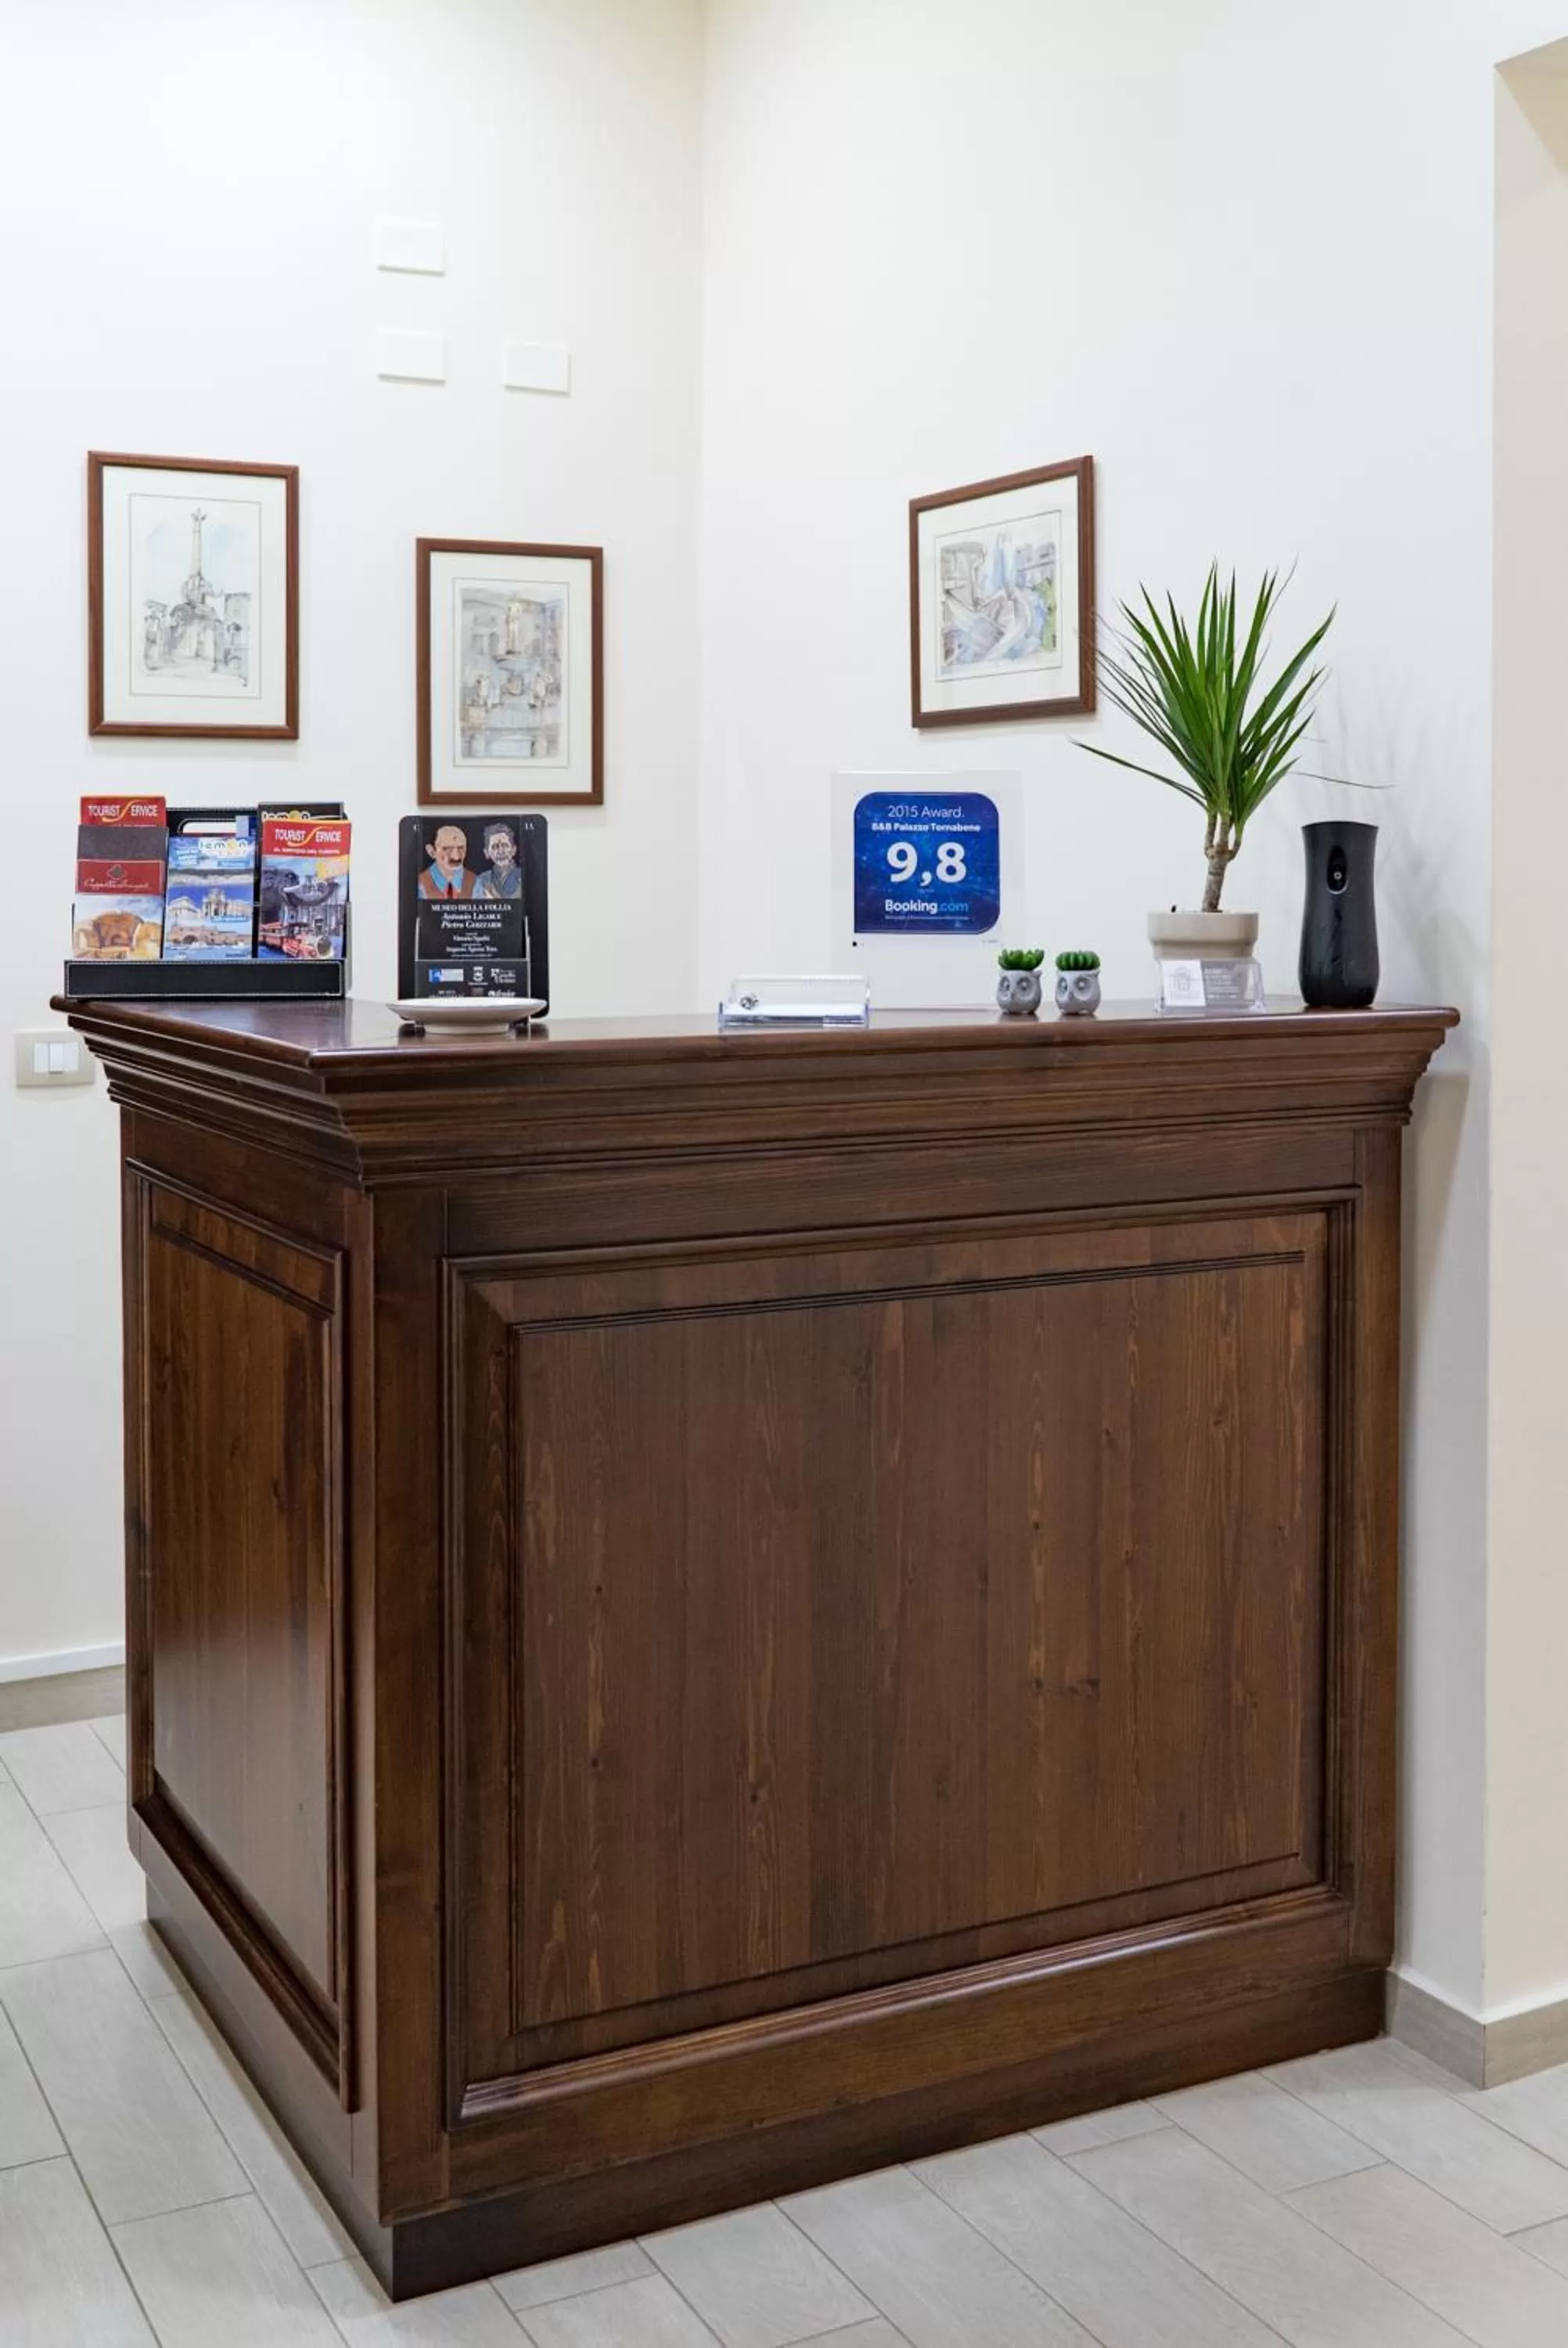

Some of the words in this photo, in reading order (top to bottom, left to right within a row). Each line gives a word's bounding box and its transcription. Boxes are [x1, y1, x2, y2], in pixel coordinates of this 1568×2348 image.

[87, 804, 120, 817] TOURIST
[887, 805, 919, 818] 2015
[921, 805, 965, 818] Award.
[871, 823, 892, 831] B&B
[893, 823, 930, 832] Palazzo
[930, 823, 981, 832] Tornabene
[274, 829, 307, 842] TOURIST
[886, 841, 968, 888] 9,8
[884, 899, 969, 914] Booking.com
